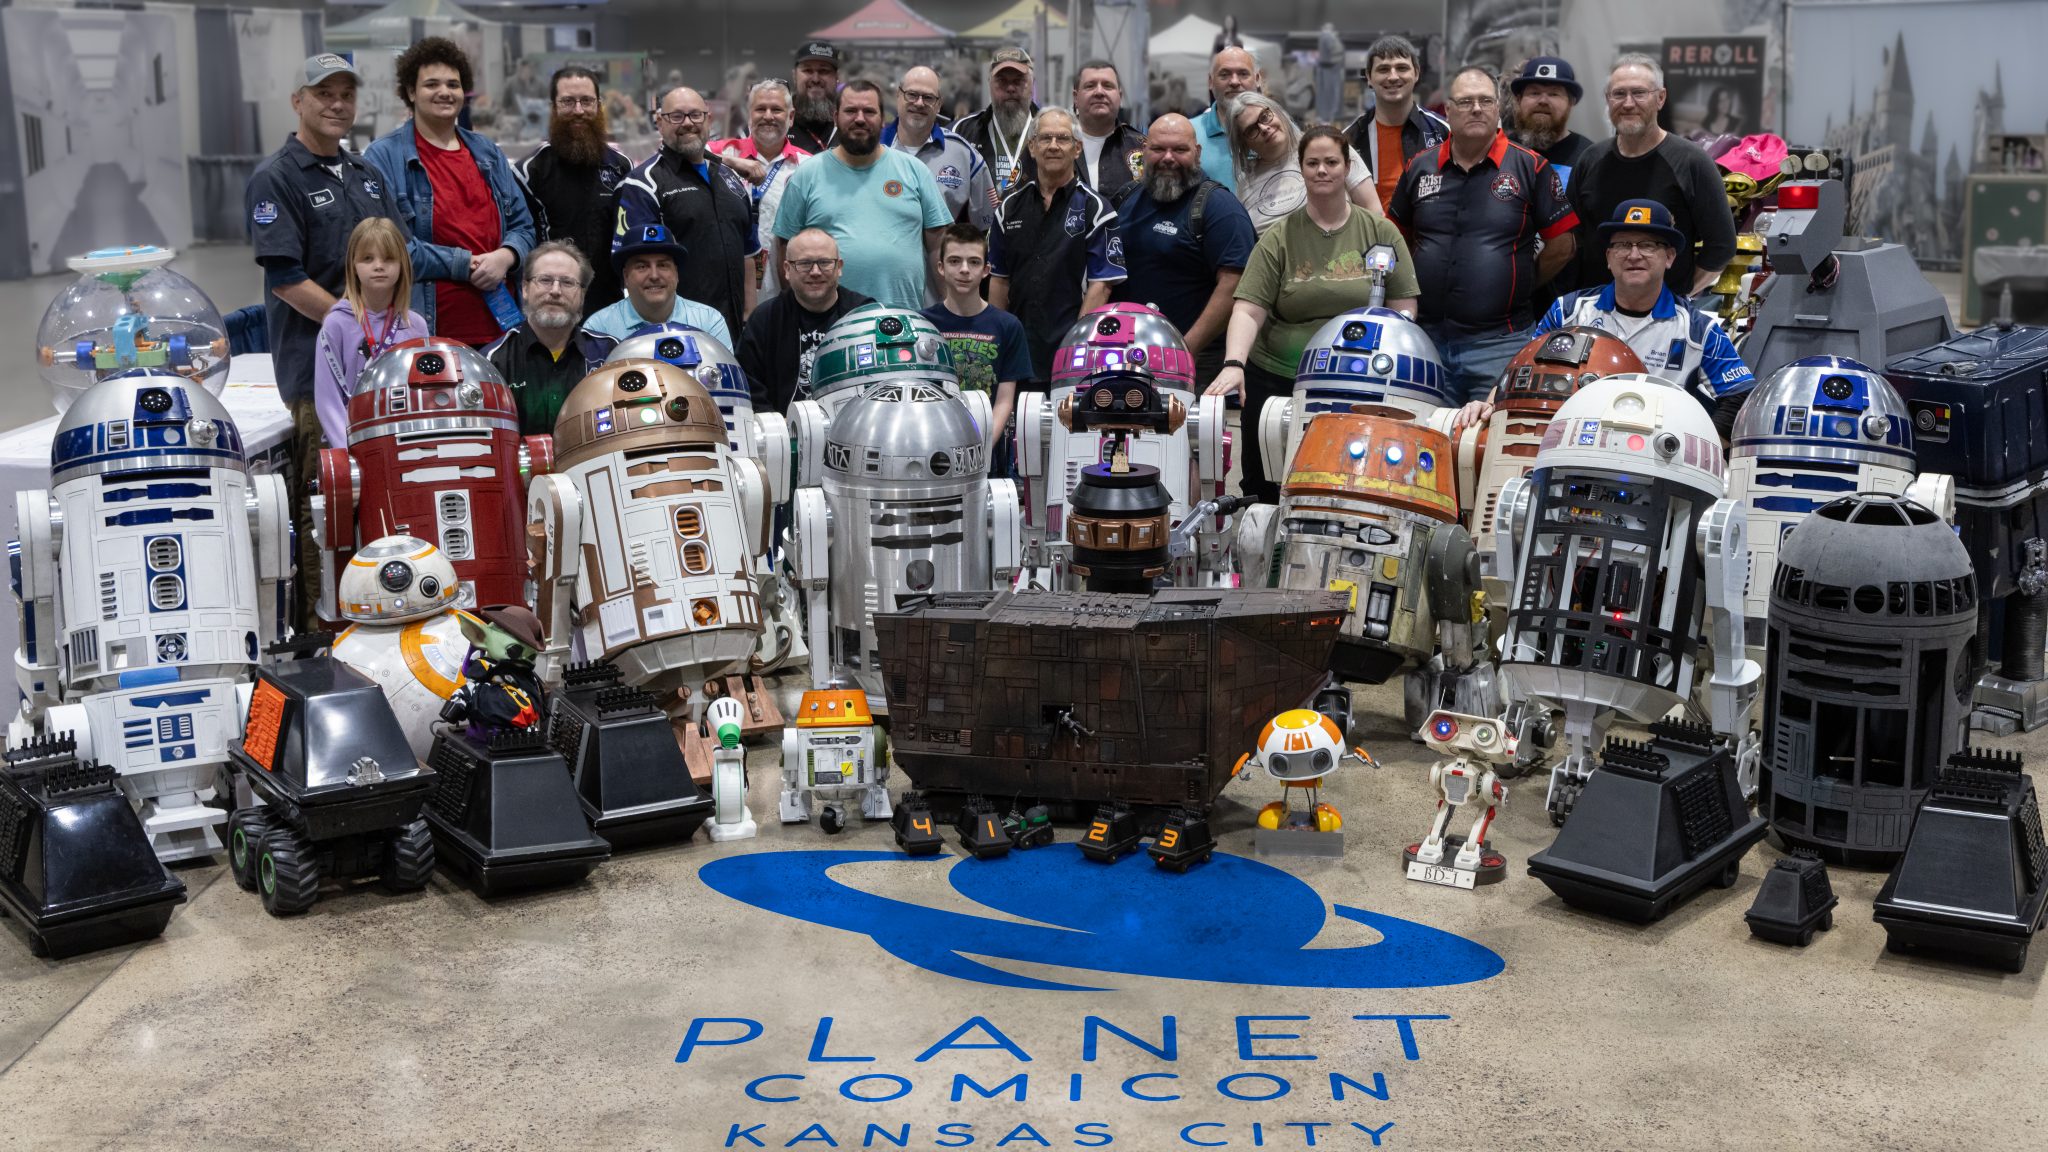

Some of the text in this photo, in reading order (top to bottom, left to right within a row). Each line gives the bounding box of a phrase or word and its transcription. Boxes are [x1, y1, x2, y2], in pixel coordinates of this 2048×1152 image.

[1669, 44, 1758, 65] REROLL
[1687, 67, 1737, 76] TAVERN
[760, 168, 778, 193] BUILDERS
[1419, 174, 1443, 188] 501ST
[912, 817, 933, 836] 4
[987, 820, 995, 838] 1
[1088, 822, 1108, 842] 2
[1159, 828, 1179, 848] 3
[675, 1015, 1450, 1063] PLANET
[745, 1072, 1389, 1103] COMICON
[725, 1122, 1393, 1148] KANSAS CITY
